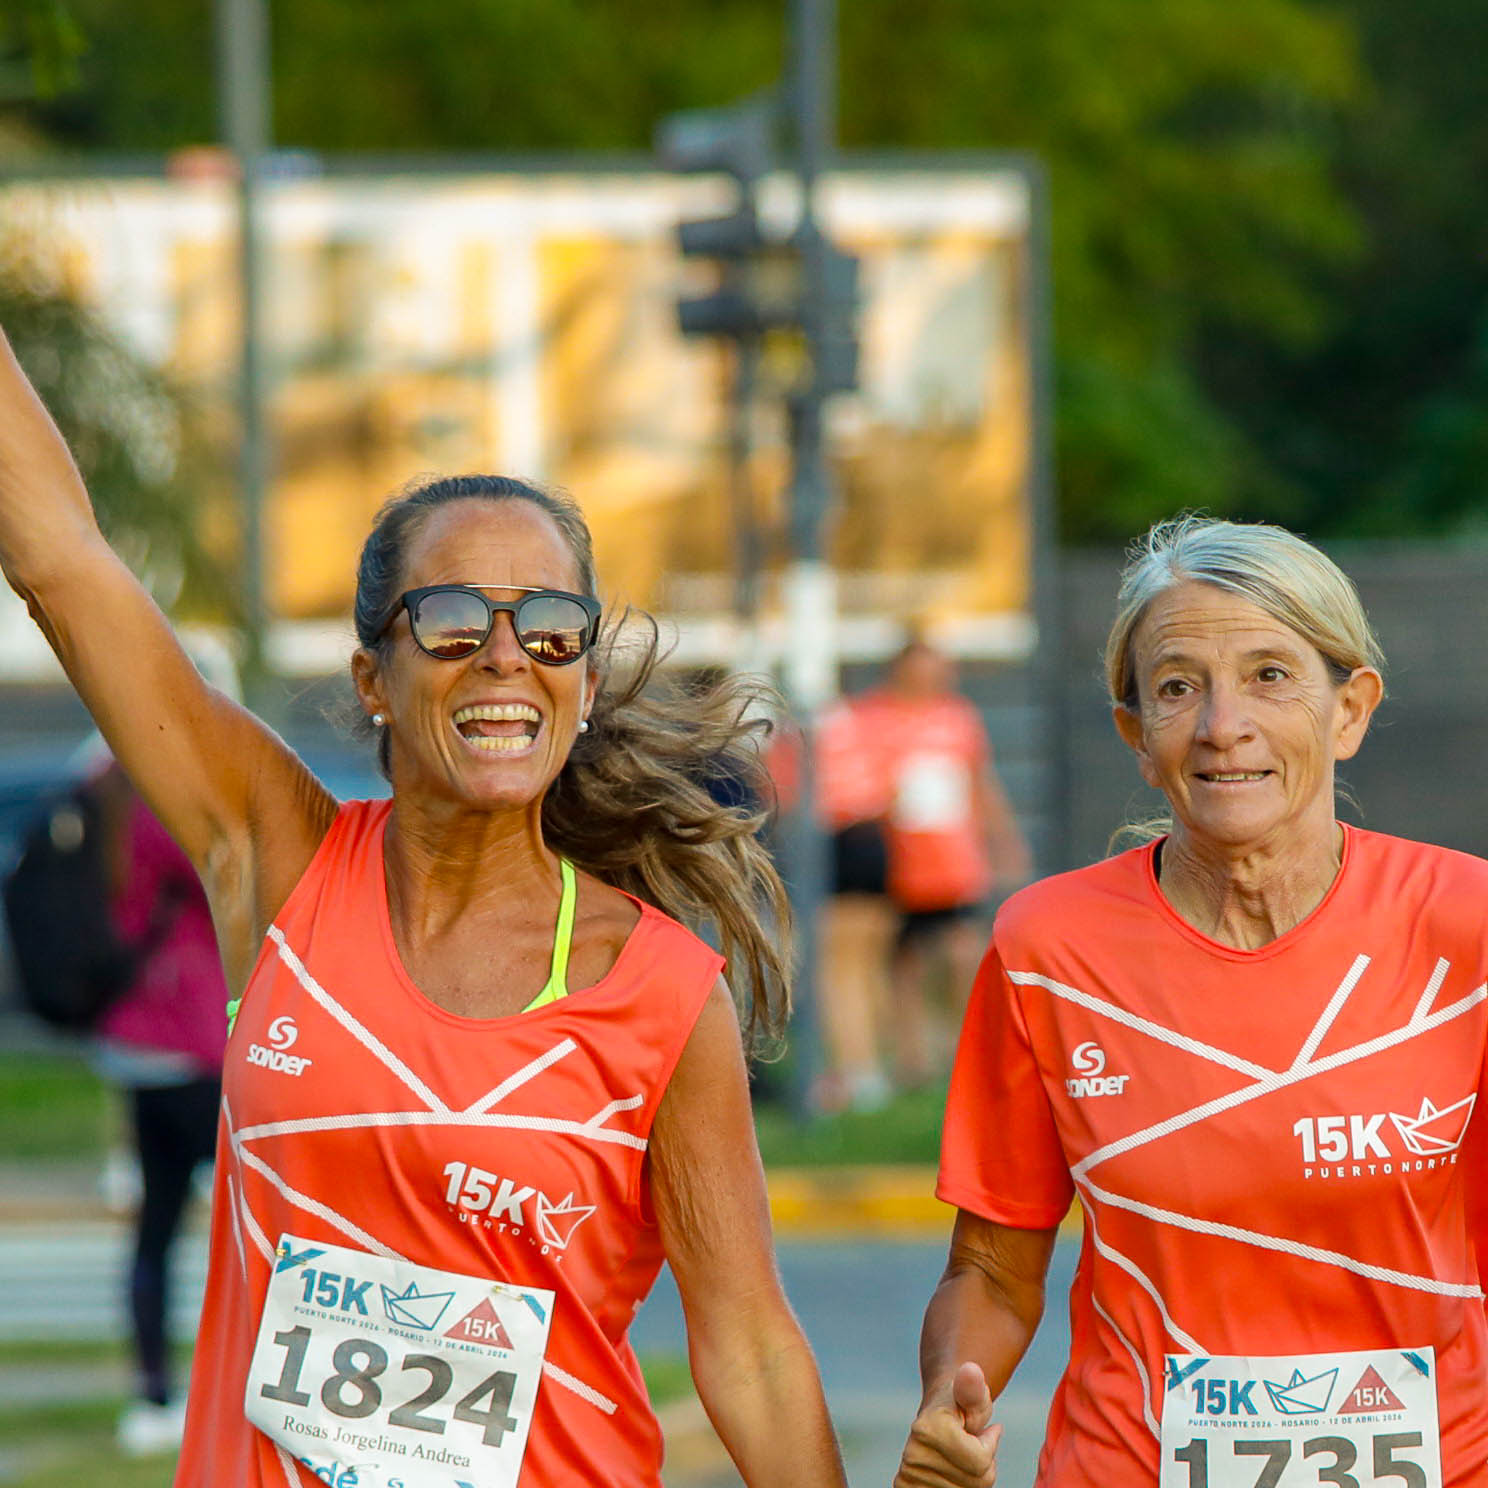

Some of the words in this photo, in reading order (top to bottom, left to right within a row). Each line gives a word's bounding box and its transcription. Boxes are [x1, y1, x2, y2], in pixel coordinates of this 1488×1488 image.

[1293, 1113, 1392, 1163] 15K
[1304, 1163, 1393, 1179] PUERTO
[1401, 1153, 1457, 1173] NORTE
[441, 1160, 537, 1228] 15K
[300, 1268, 374, 1316] 15K
[463, 1317, 500, 1341] 15K
[260, 1325, 518, 1449] 1824
[1191, 1378, 1259, 1415] 15K
[1353, 1386, 1390, 1407] 15K
[282, 1415, 328, 1440] Rosas
[333, 1427, 407, 1455] Jorgelina
[411, 1443, 471, 1467] Andrea
[1281, 1419, 1319, 1428] ROSARIO
